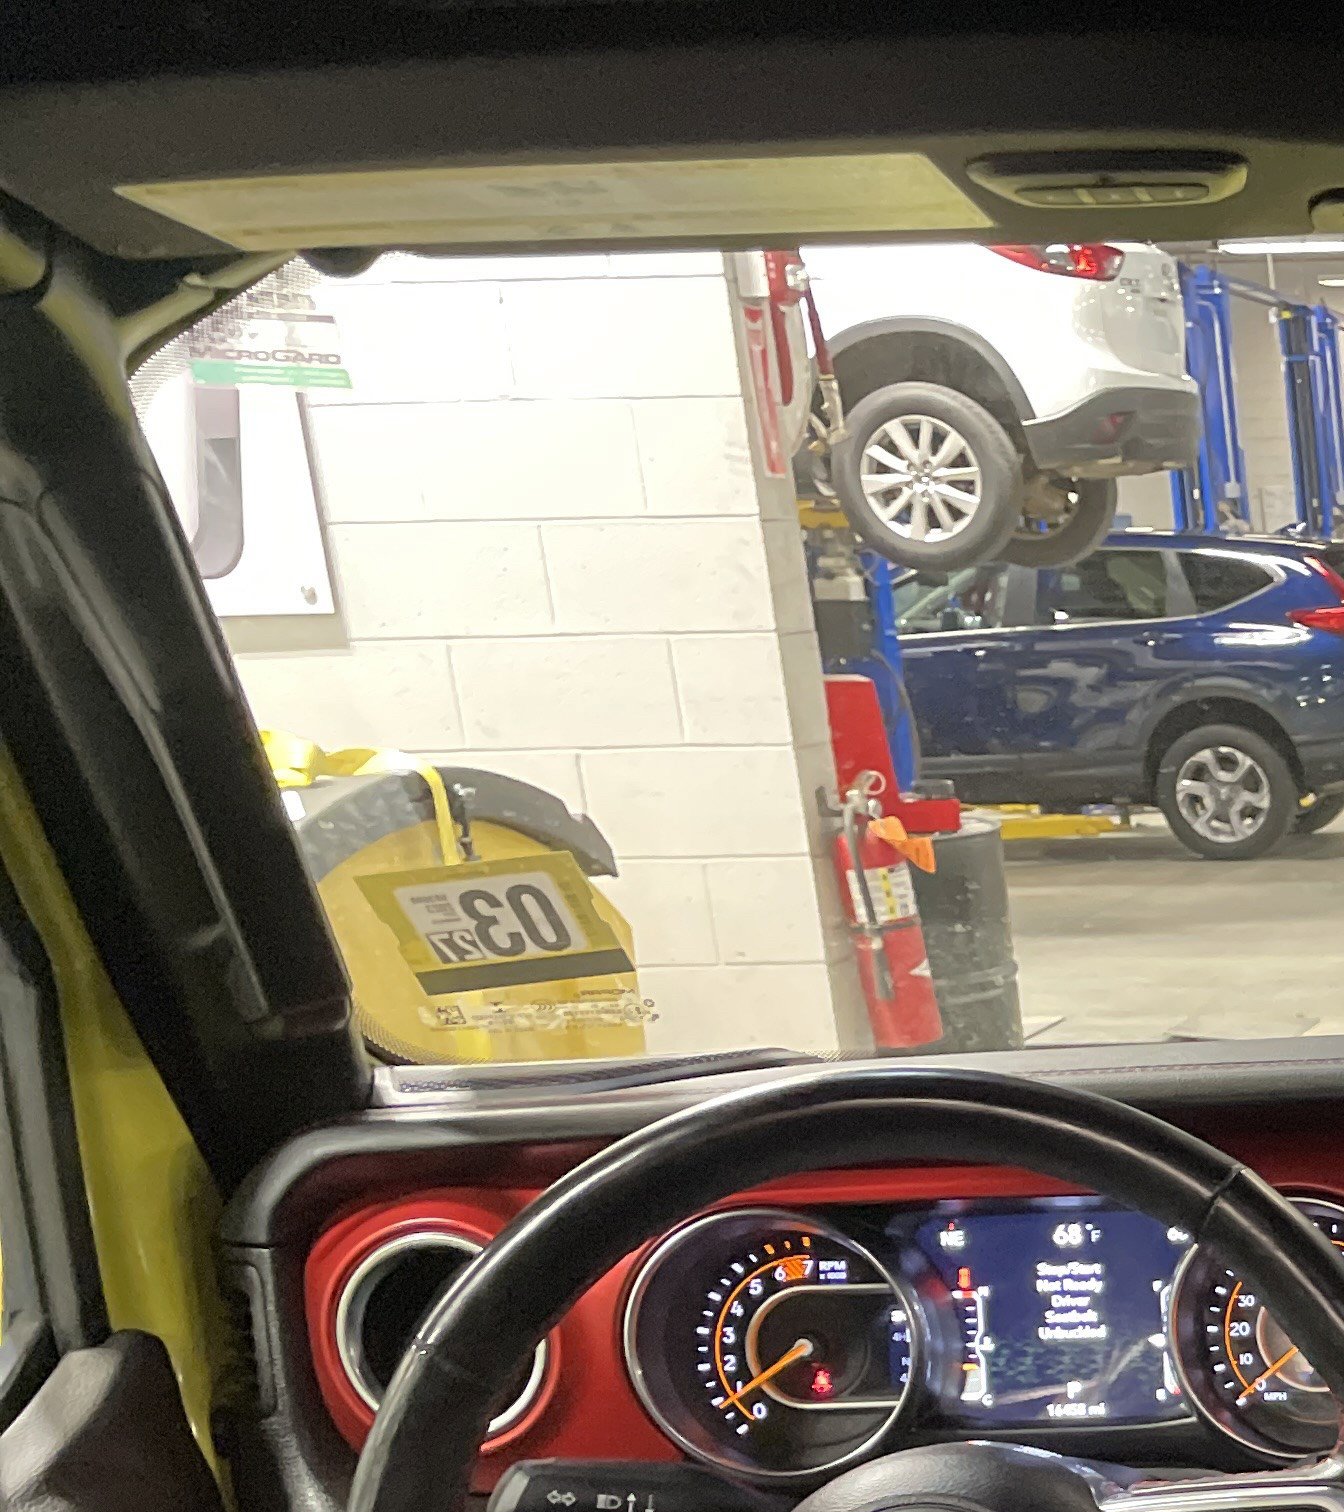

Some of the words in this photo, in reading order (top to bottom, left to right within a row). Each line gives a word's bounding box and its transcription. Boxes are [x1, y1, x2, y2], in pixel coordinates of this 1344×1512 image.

[939, 1229, 965, 1247] NE
[773, 1266, 787, 1281] 6
[801, 1260, 813, 1276] 7
[818, 1260, 846, 1271] RPM
[749, 1278, 763, 1295] 5
[730, 1300, 744, 1317] 4
[1236, 1293, 1256, 1308] 30
[722, 1326, 736, 1344] 3
[1229, 1320, 1251, 1337] 20
[722, 1354, 737, 1372] 2
[1238, 1351, 1254, 1365] 10
[1263, 1391, 1288, 1402] MPH
[752, 1402, 768, 1419] 0
